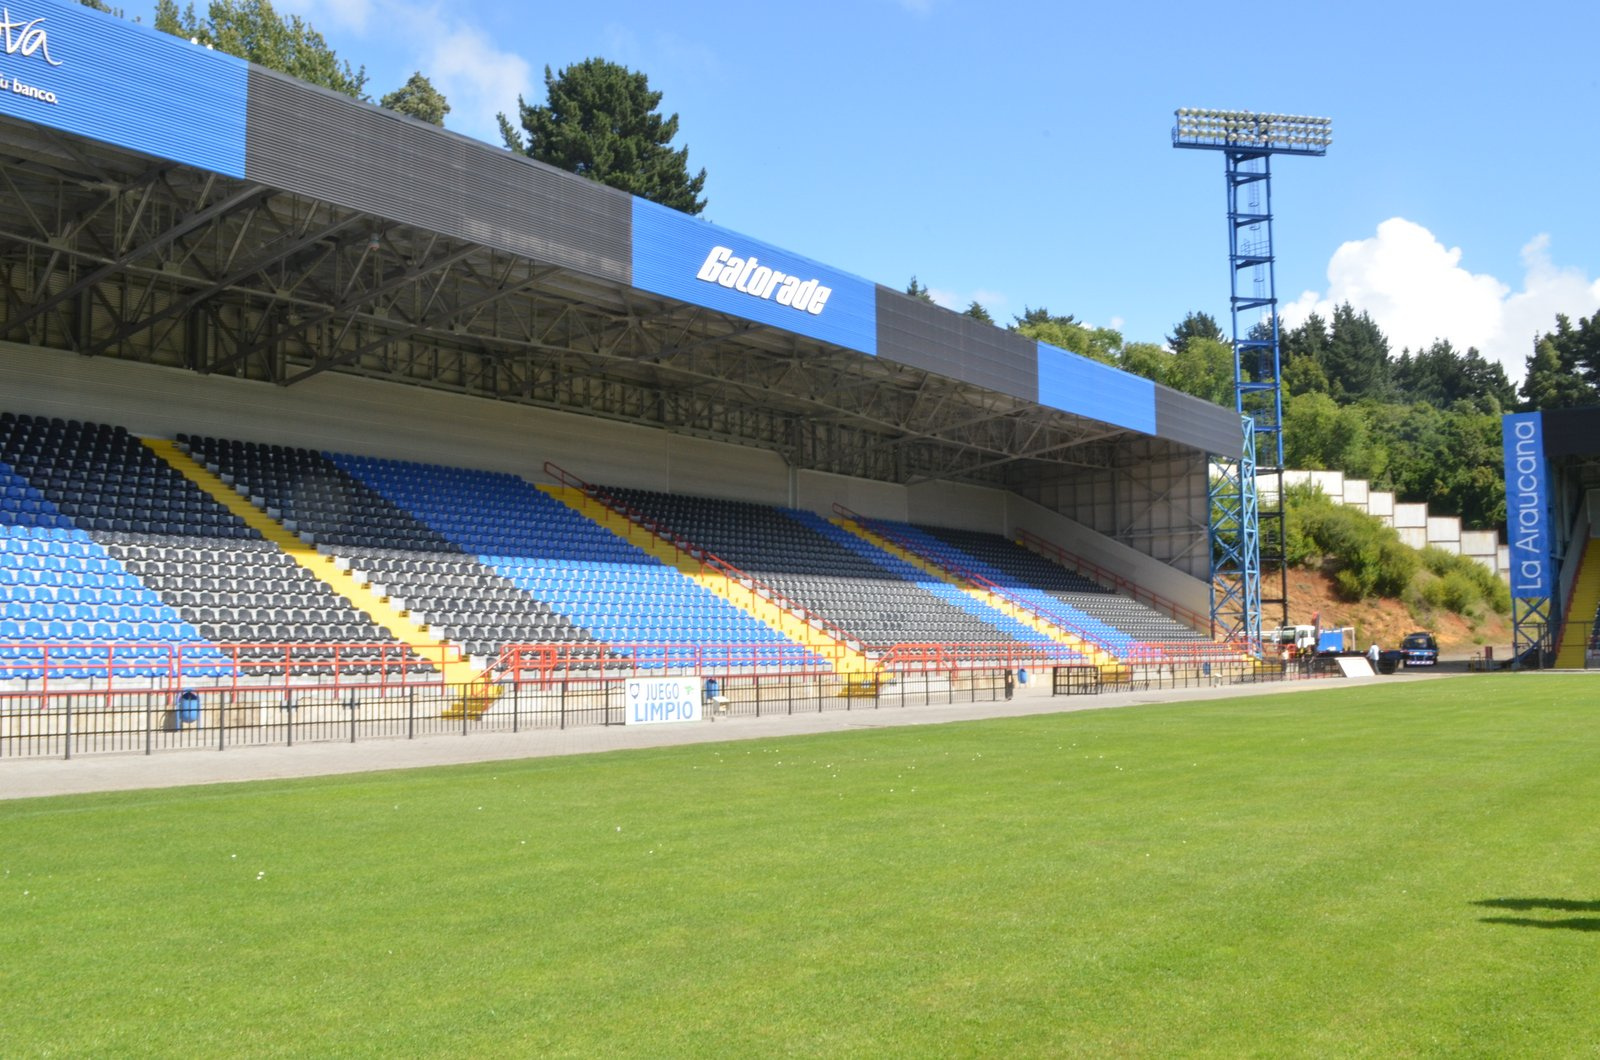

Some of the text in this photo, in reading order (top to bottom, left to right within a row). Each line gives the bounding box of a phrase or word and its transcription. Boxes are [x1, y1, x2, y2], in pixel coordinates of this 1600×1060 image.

[0, 7, 64, 66] ta
[13, 78, 58, 105] banco.
[696, 245, 833, 316] Gatorade
[1515, 420, 1542, 590] La Araucana
[634, 700, 694, 722] LIMPIO
[646, 682, 680, 701] JUEGO
